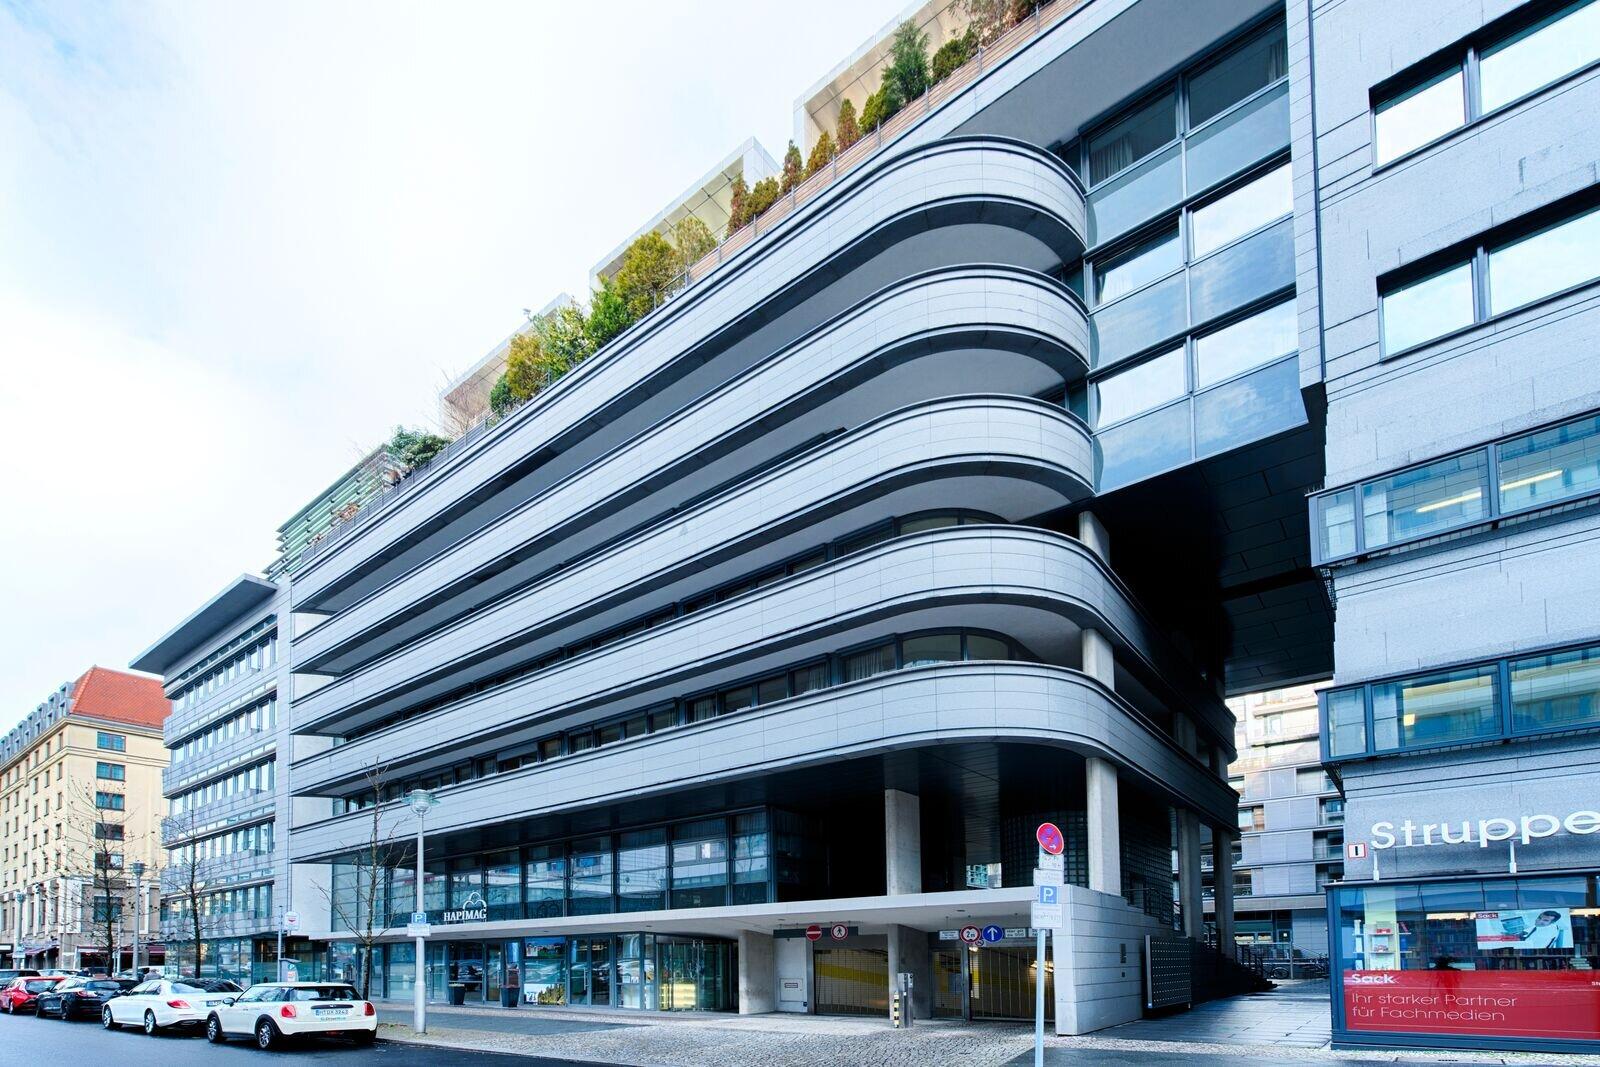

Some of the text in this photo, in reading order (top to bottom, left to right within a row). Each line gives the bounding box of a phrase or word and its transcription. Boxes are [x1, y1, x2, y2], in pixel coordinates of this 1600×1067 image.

[1371, 810, 1600, 850] Struppe
[1043, 887, 1054, 903] P
[443, 908, 487, 922] HAPIMAG
[1351, 973, 1395, 984] Sack
[1352, 993, 1518, 1007] Ihr starker Partner
[1352, 1006, 1505, 1021] für Fachmedien
